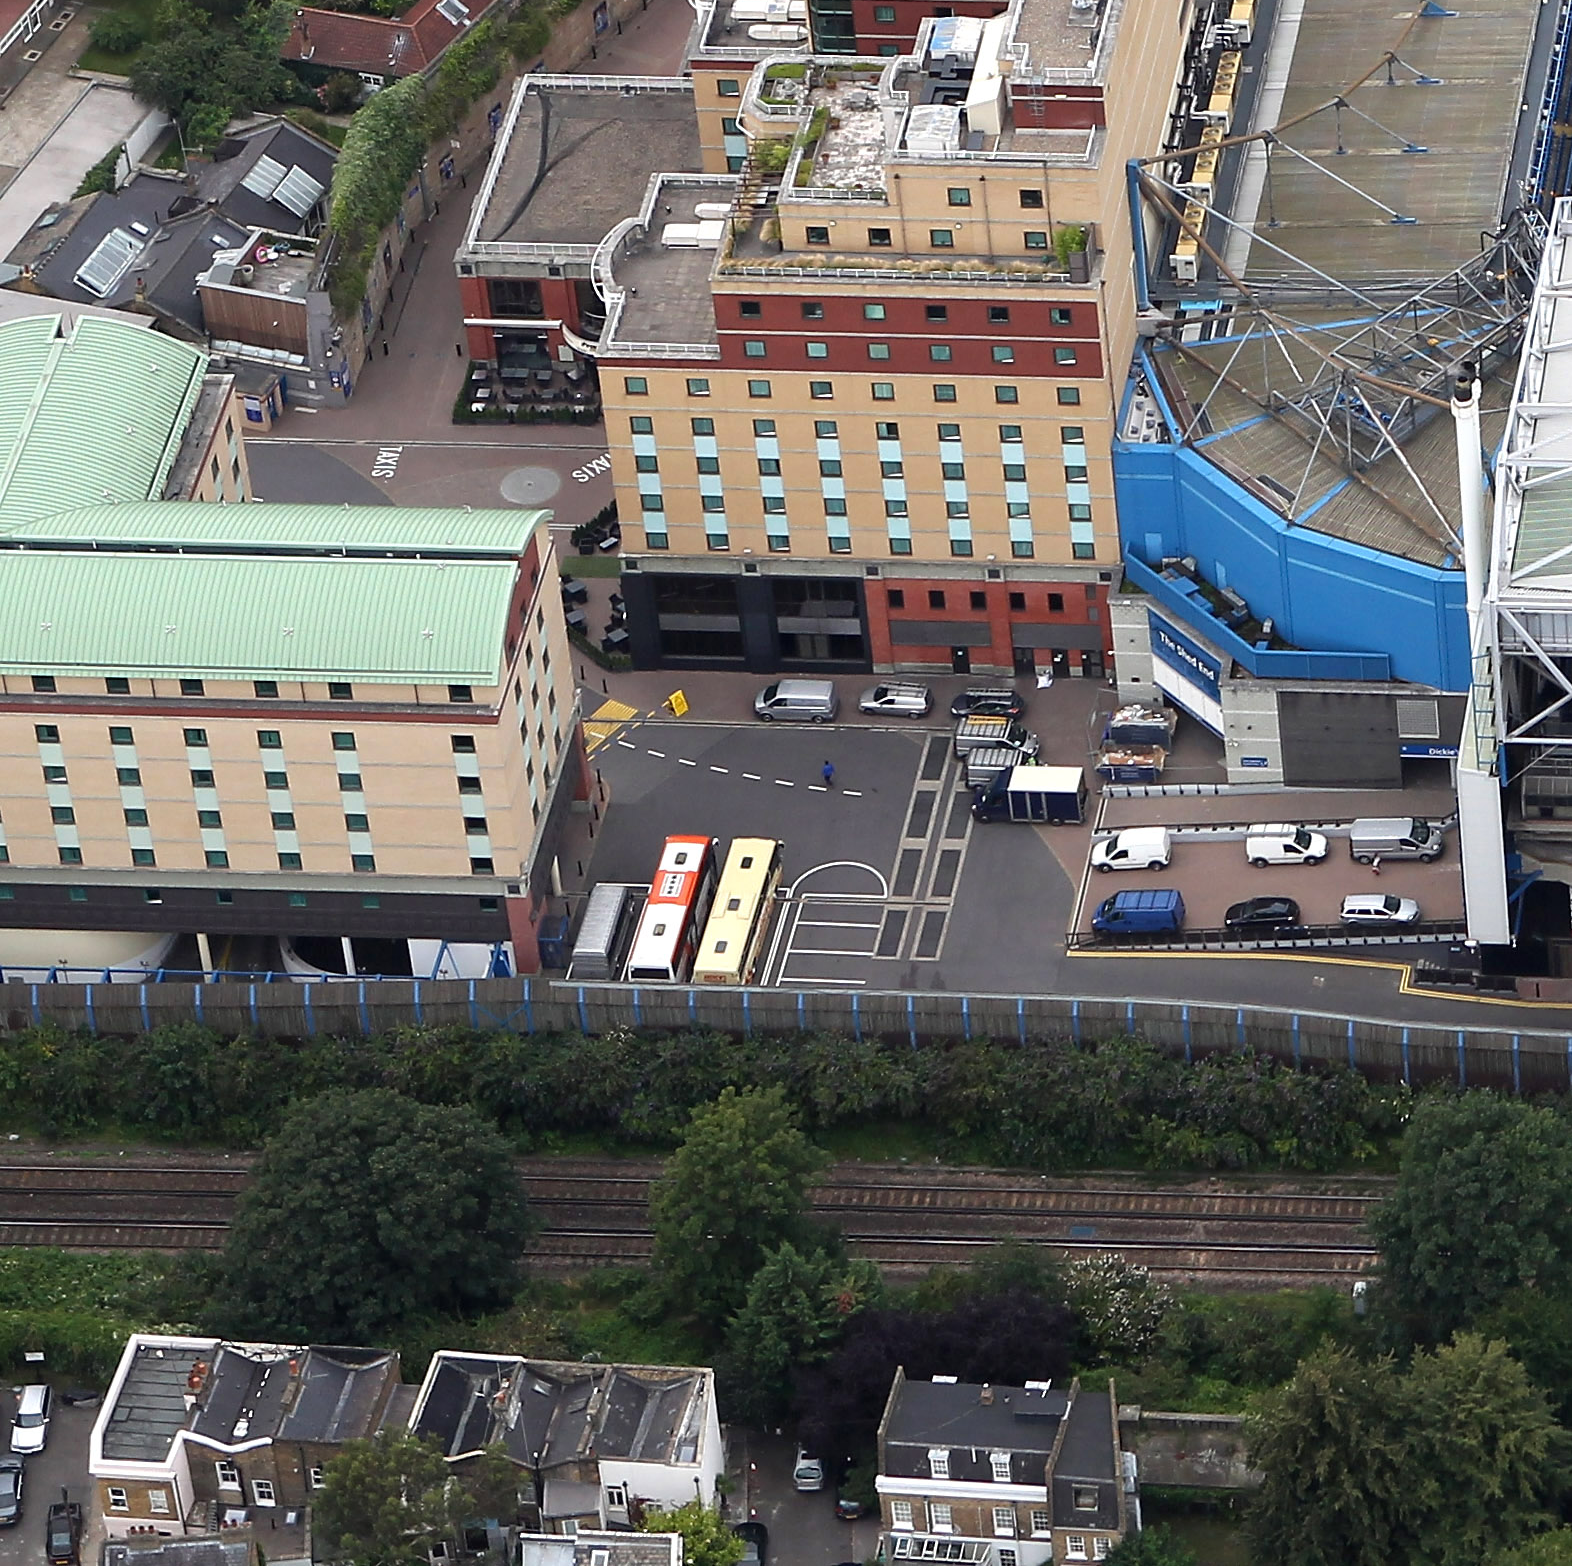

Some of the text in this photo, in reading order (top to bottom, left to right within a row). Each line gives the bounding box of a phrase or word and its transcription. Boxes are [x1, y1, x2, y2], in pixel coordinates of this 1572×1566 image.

[372, 446, 404, 479] TAXIS
[572, 452, 612, 483] AXIS
[1159, 630, 1215, 681] The Shed End
